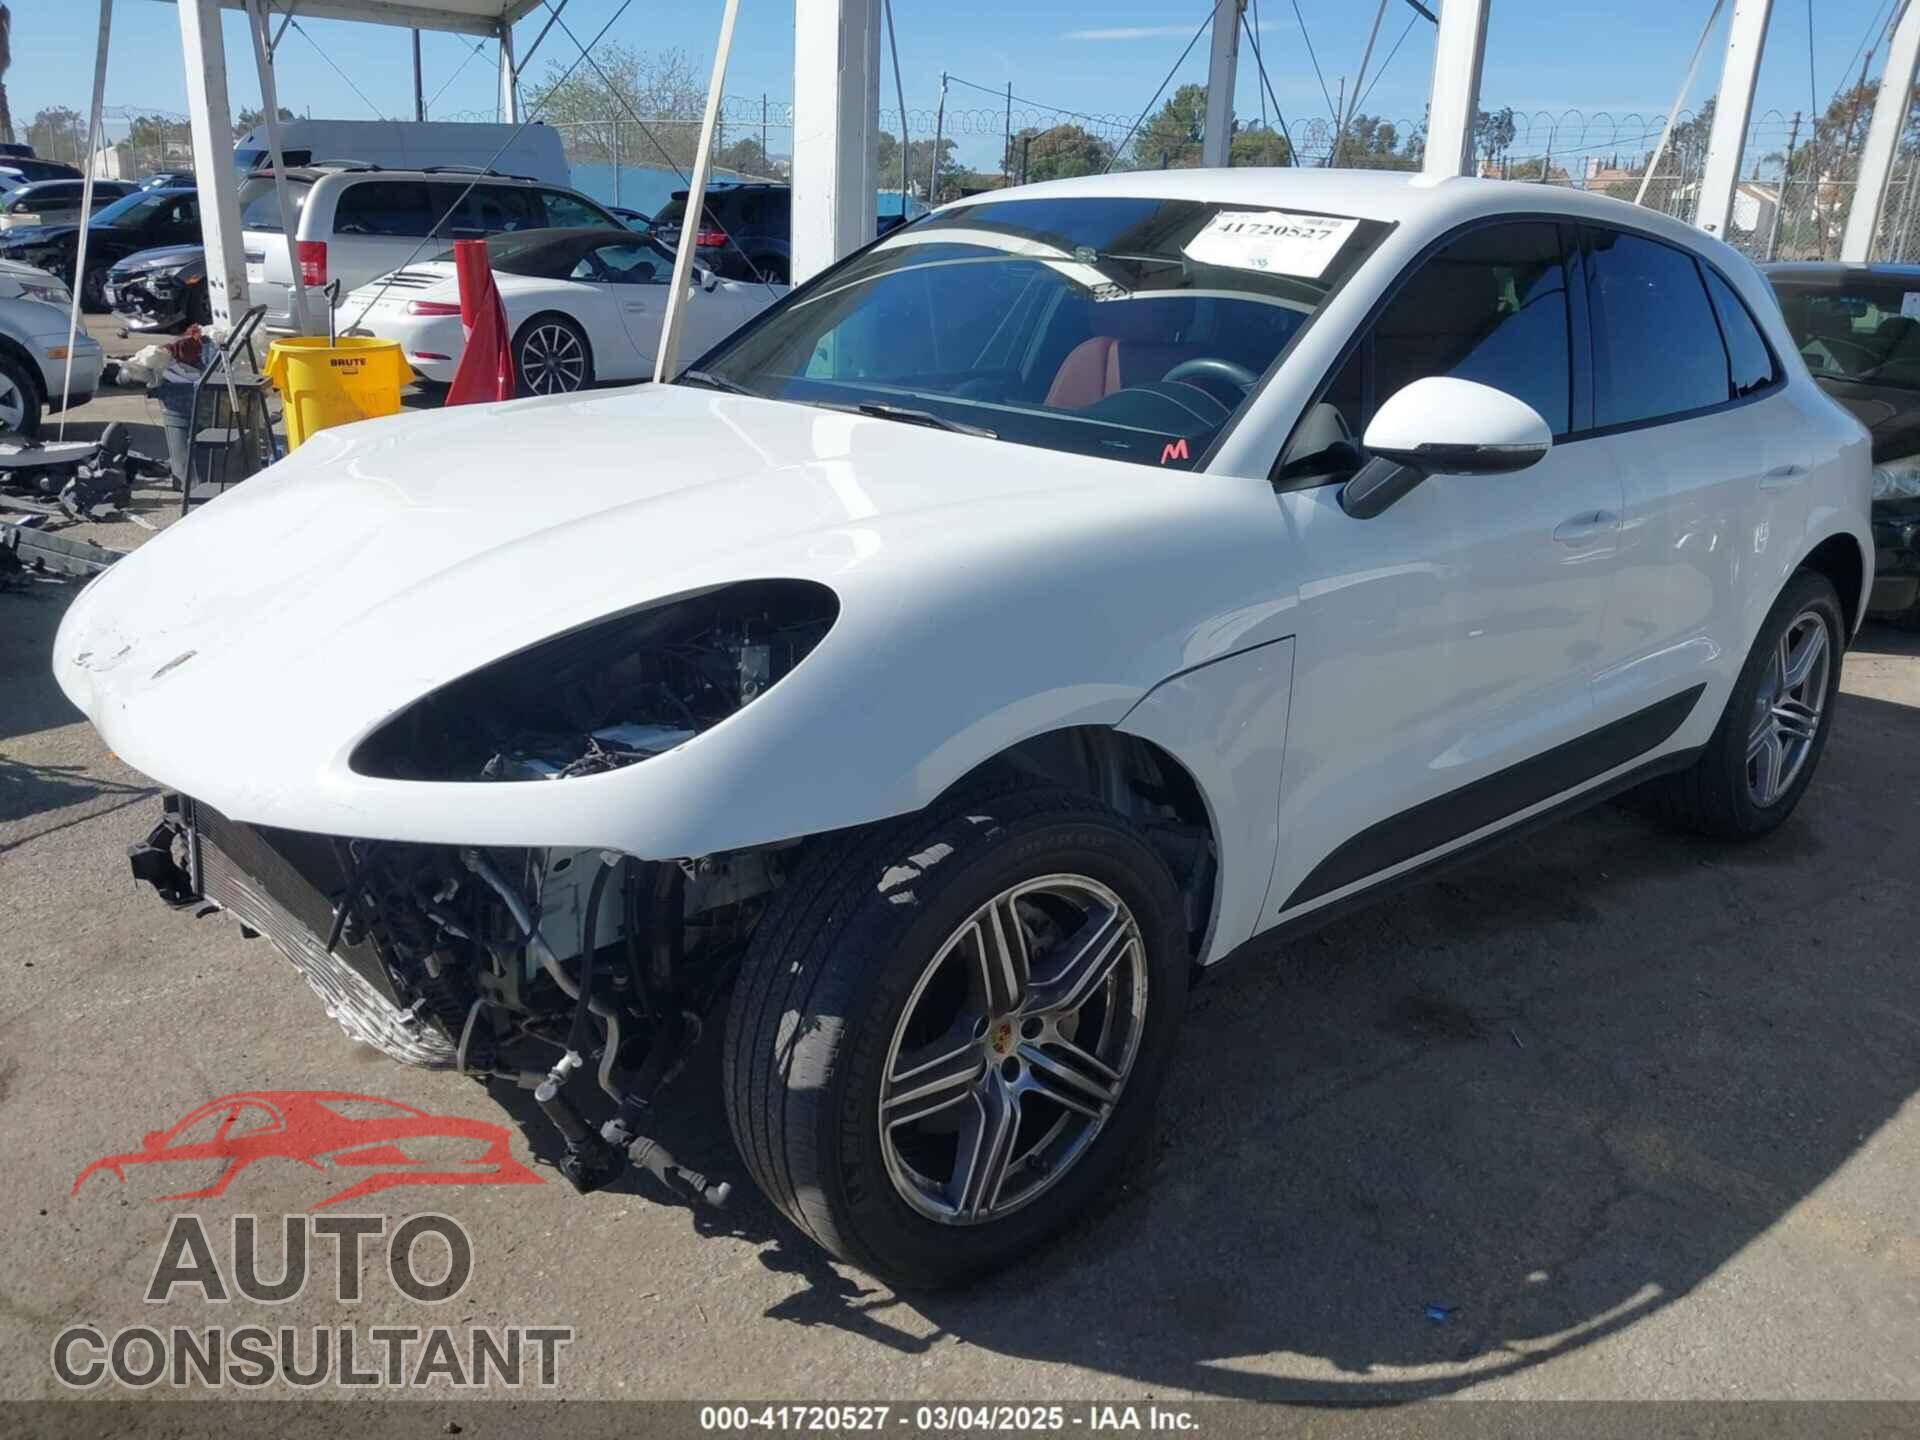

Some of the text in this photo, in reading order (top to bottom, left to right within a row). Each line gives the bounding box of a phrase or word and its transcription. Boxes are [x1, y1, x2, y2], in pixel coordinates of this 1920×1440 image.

[1219, 222, 1332, 240] 41720527
[330, 358, 366, 367] BRUTE
[1160, 438, 1189, 464] M
